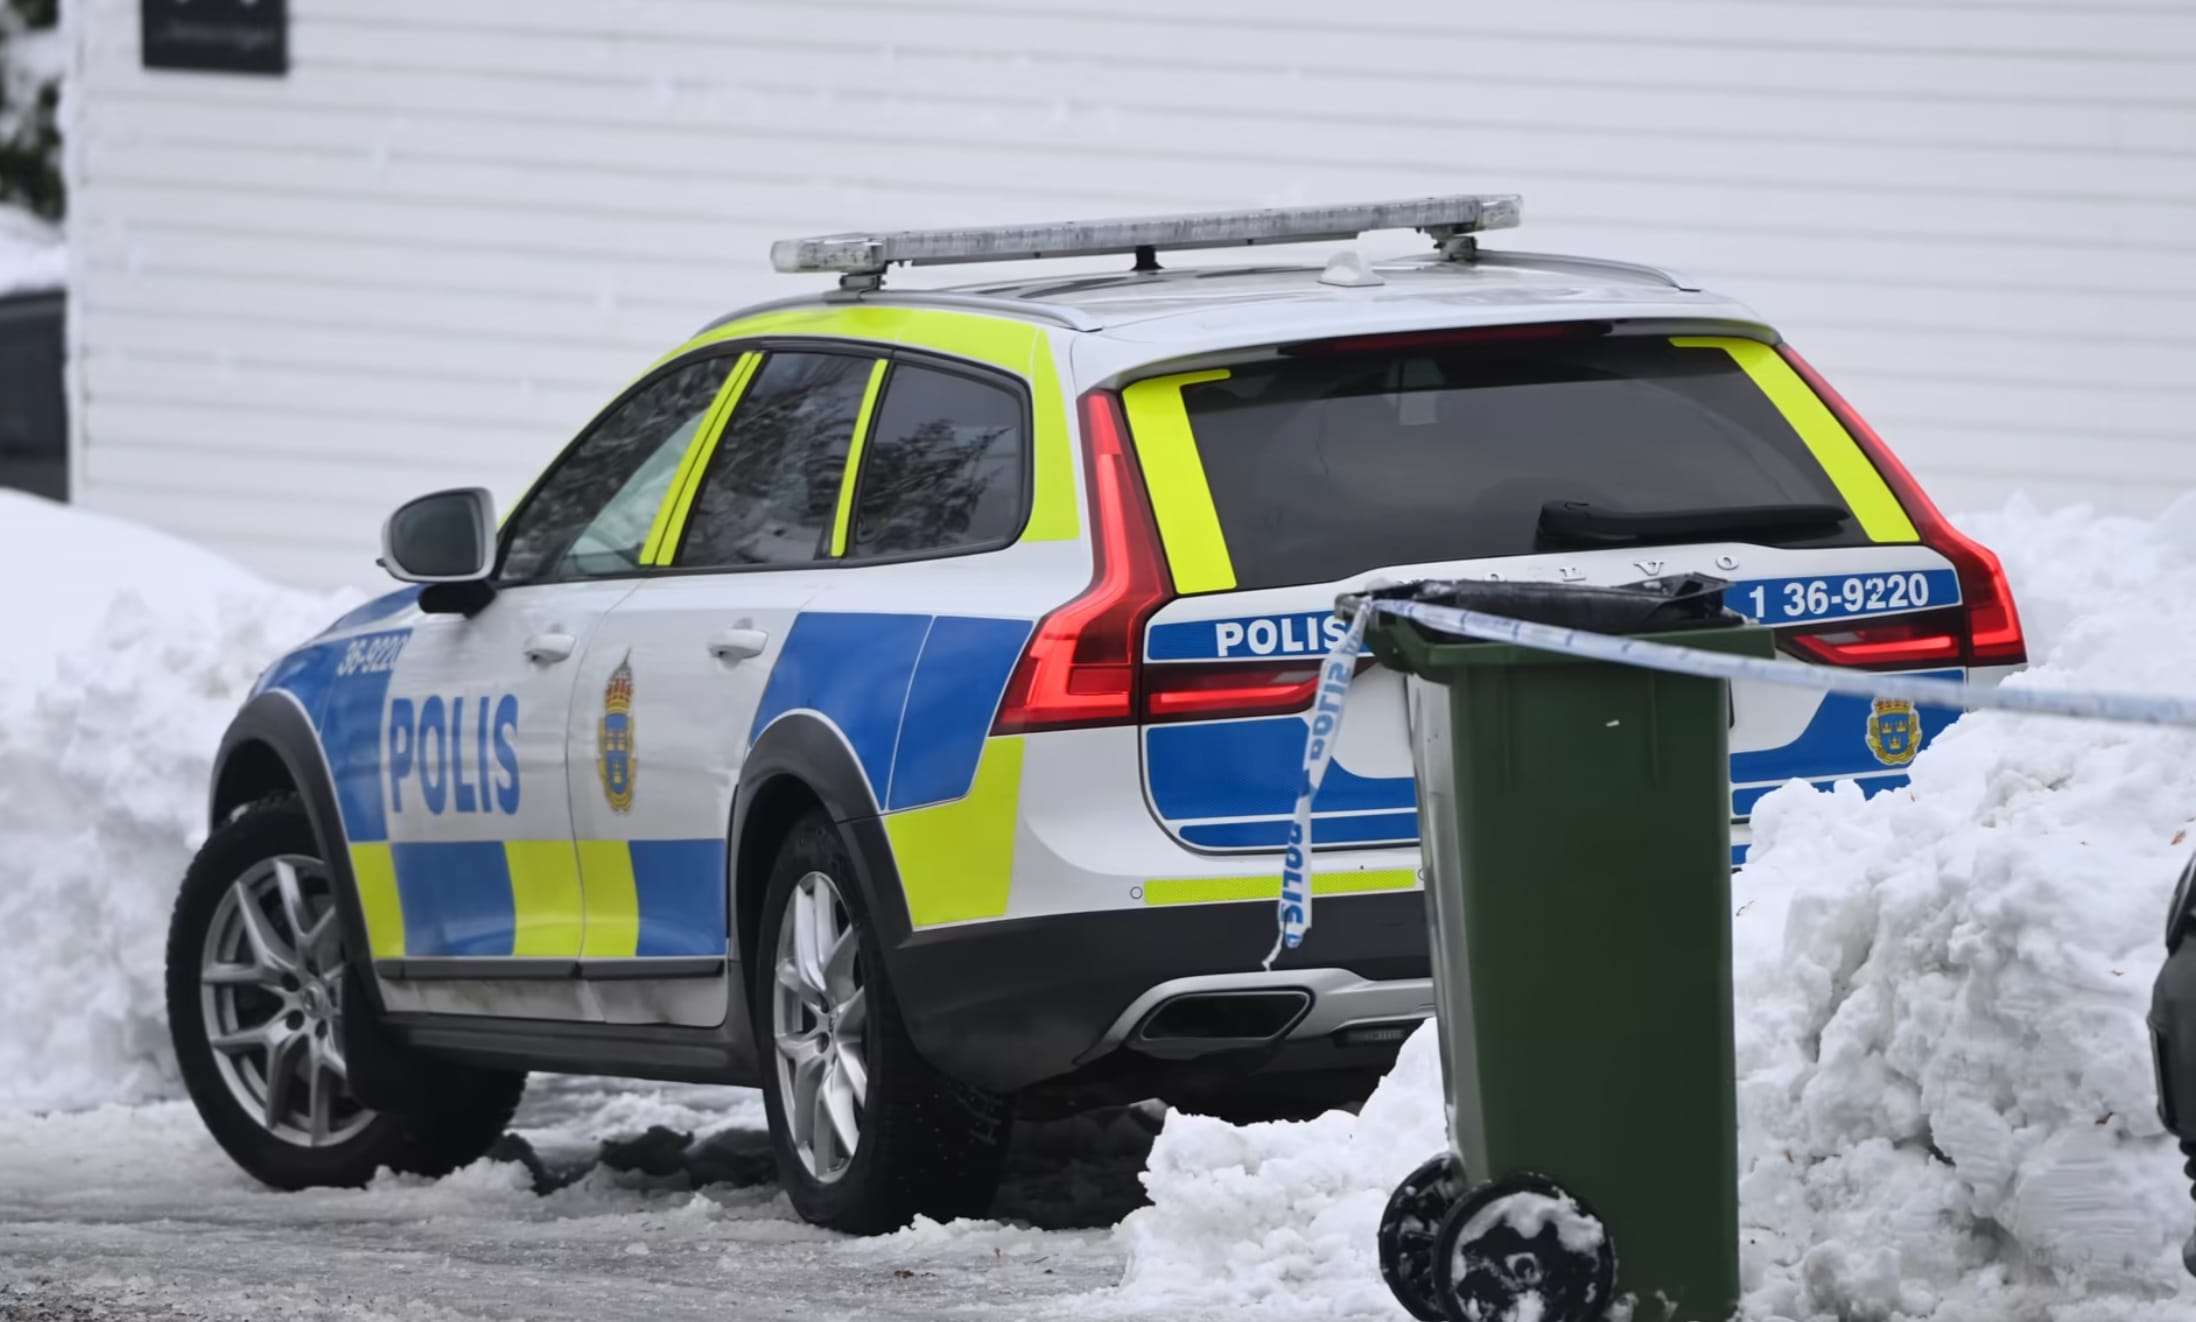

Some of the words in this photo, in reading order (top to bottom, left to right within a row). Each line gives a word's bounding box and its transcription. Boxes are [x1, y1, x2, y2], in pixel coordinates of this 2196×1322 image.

[1749, 585, 1765, 618] 1
[1783, 573, 1929, 616] 36-9220
[1215, 615, 1347, 657] POLIS
[389, 693, 520, 816] POLIS
